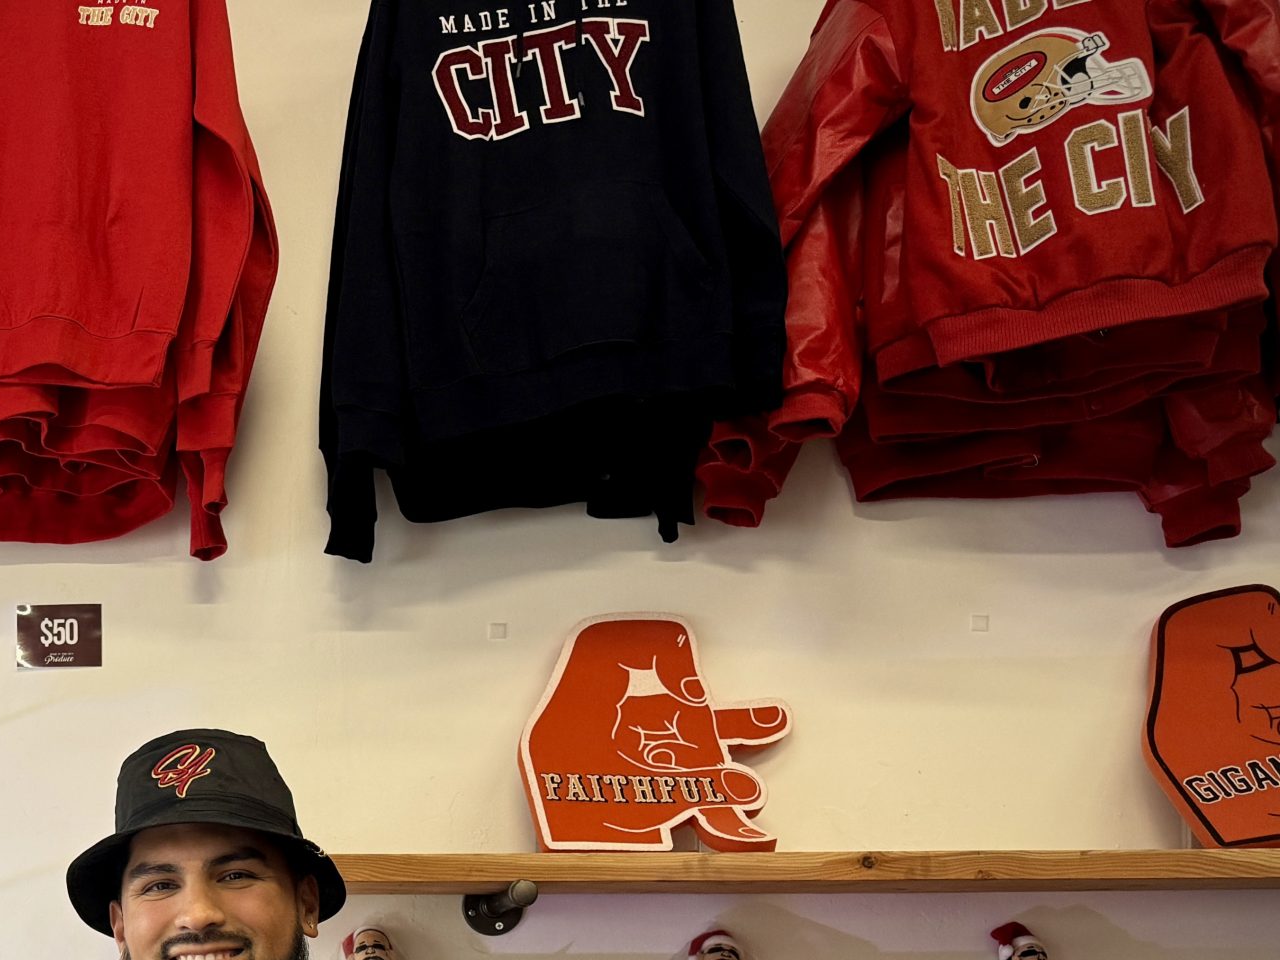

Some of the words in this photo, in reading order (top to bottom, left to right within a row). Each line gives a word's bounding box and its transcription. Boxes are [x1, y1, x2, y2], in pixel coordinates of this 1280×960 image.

[78, 6, 114, 26] THE
[120, 5, 159, 28] CITY
[439, 9, 510, 34] MADE
[528, 1, 556, 23] IN
[431, 17, 651, 141] CITY
[40, 617, 79, 648] $50
[540, 772, 727, 804] FAITHFUL
